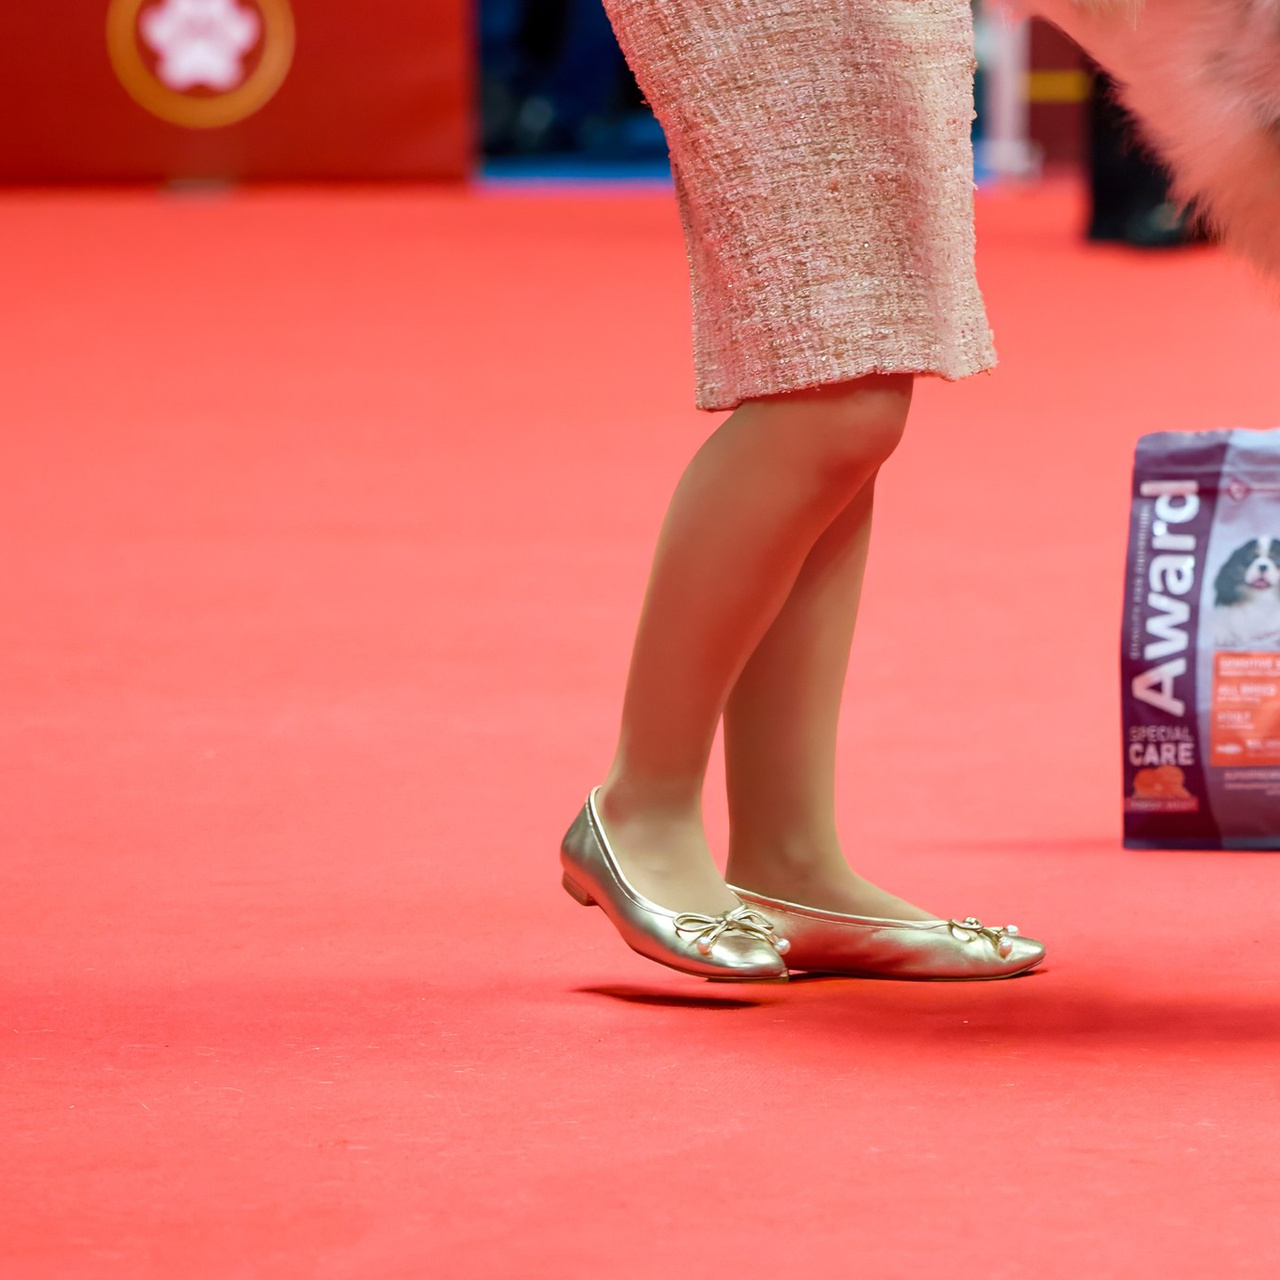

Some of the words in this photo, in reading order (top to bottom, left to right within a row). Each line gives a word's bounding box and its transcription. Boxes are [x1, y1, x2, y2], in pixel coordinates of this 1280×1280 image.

[1131, 479, 1199, 716] Award
[1129, 725, 1193, 741] SPECIAL
[1129, 742, 1194, 766] CARE
